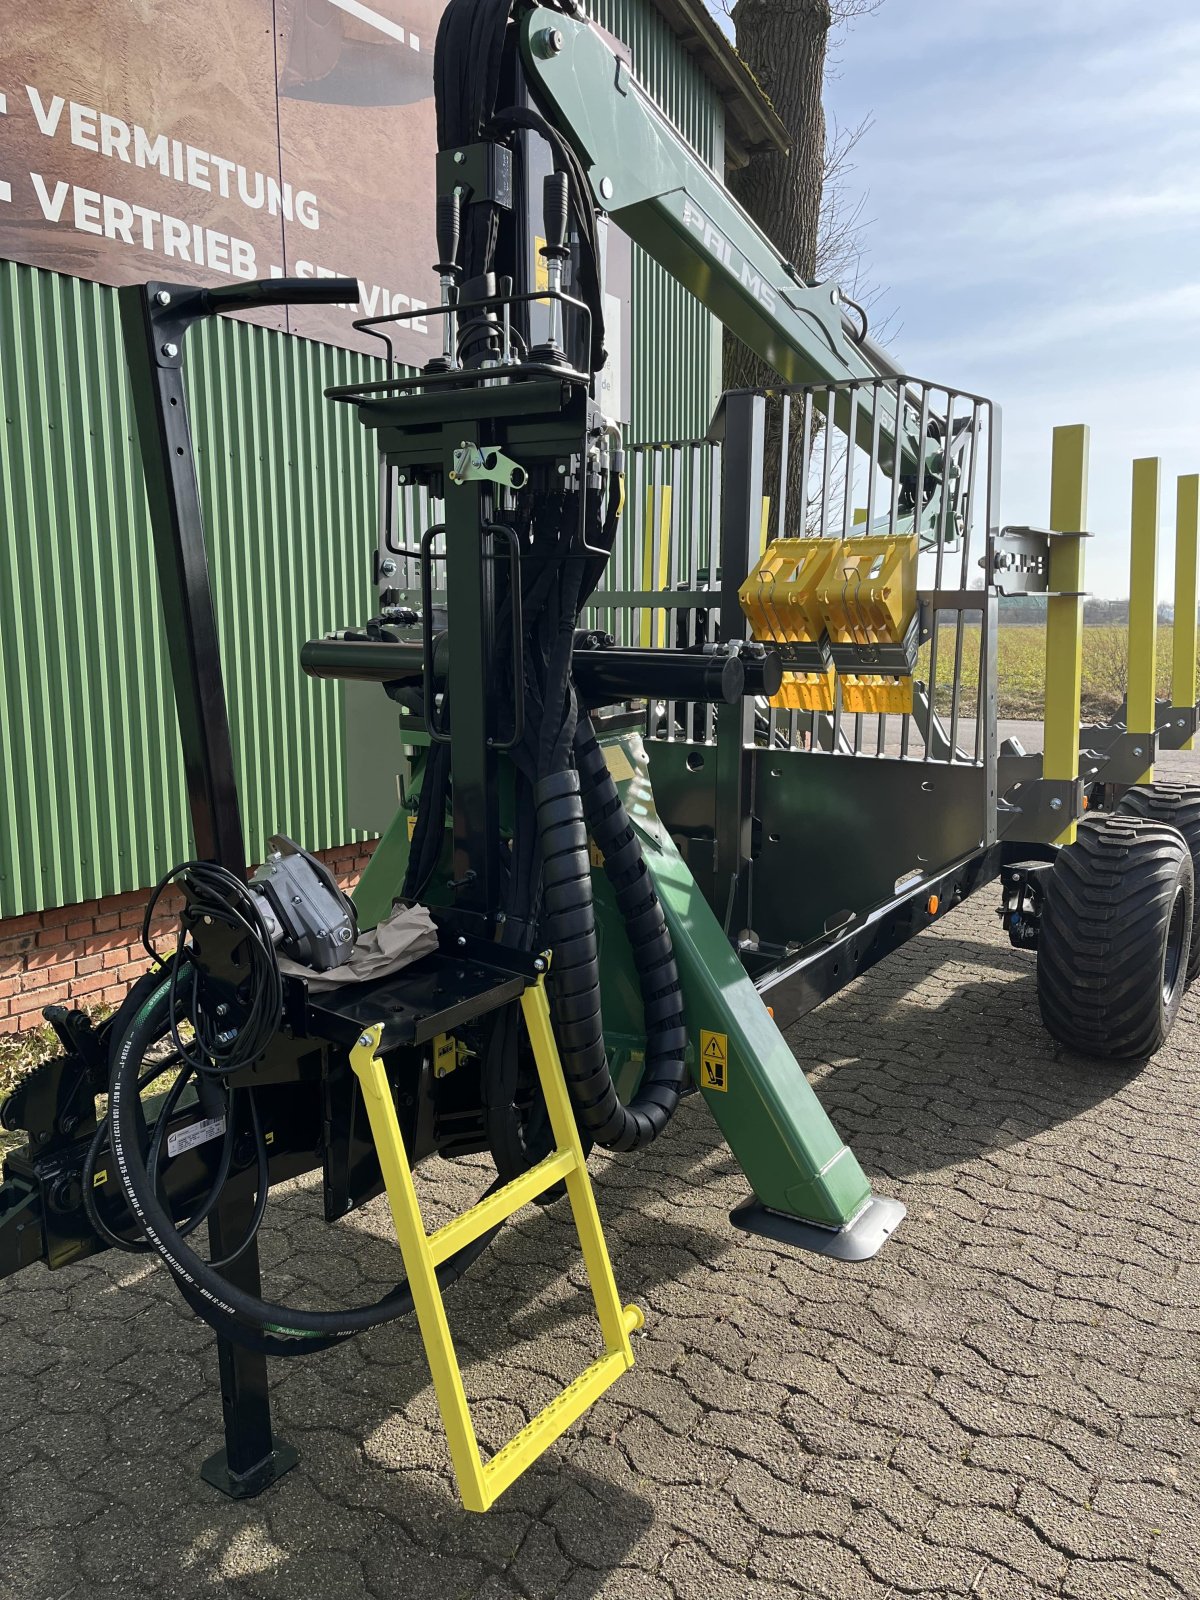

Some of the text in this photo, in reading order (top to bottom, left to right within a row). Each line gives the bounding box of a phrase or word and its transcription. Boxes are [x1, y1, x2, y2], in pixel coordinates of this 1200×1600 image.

[25, 84, 320, 230] VERMIETUNG
[29, 171, 428, 334] VERTRIEB SVICE
[682, 199, 777, 316] PALMS
